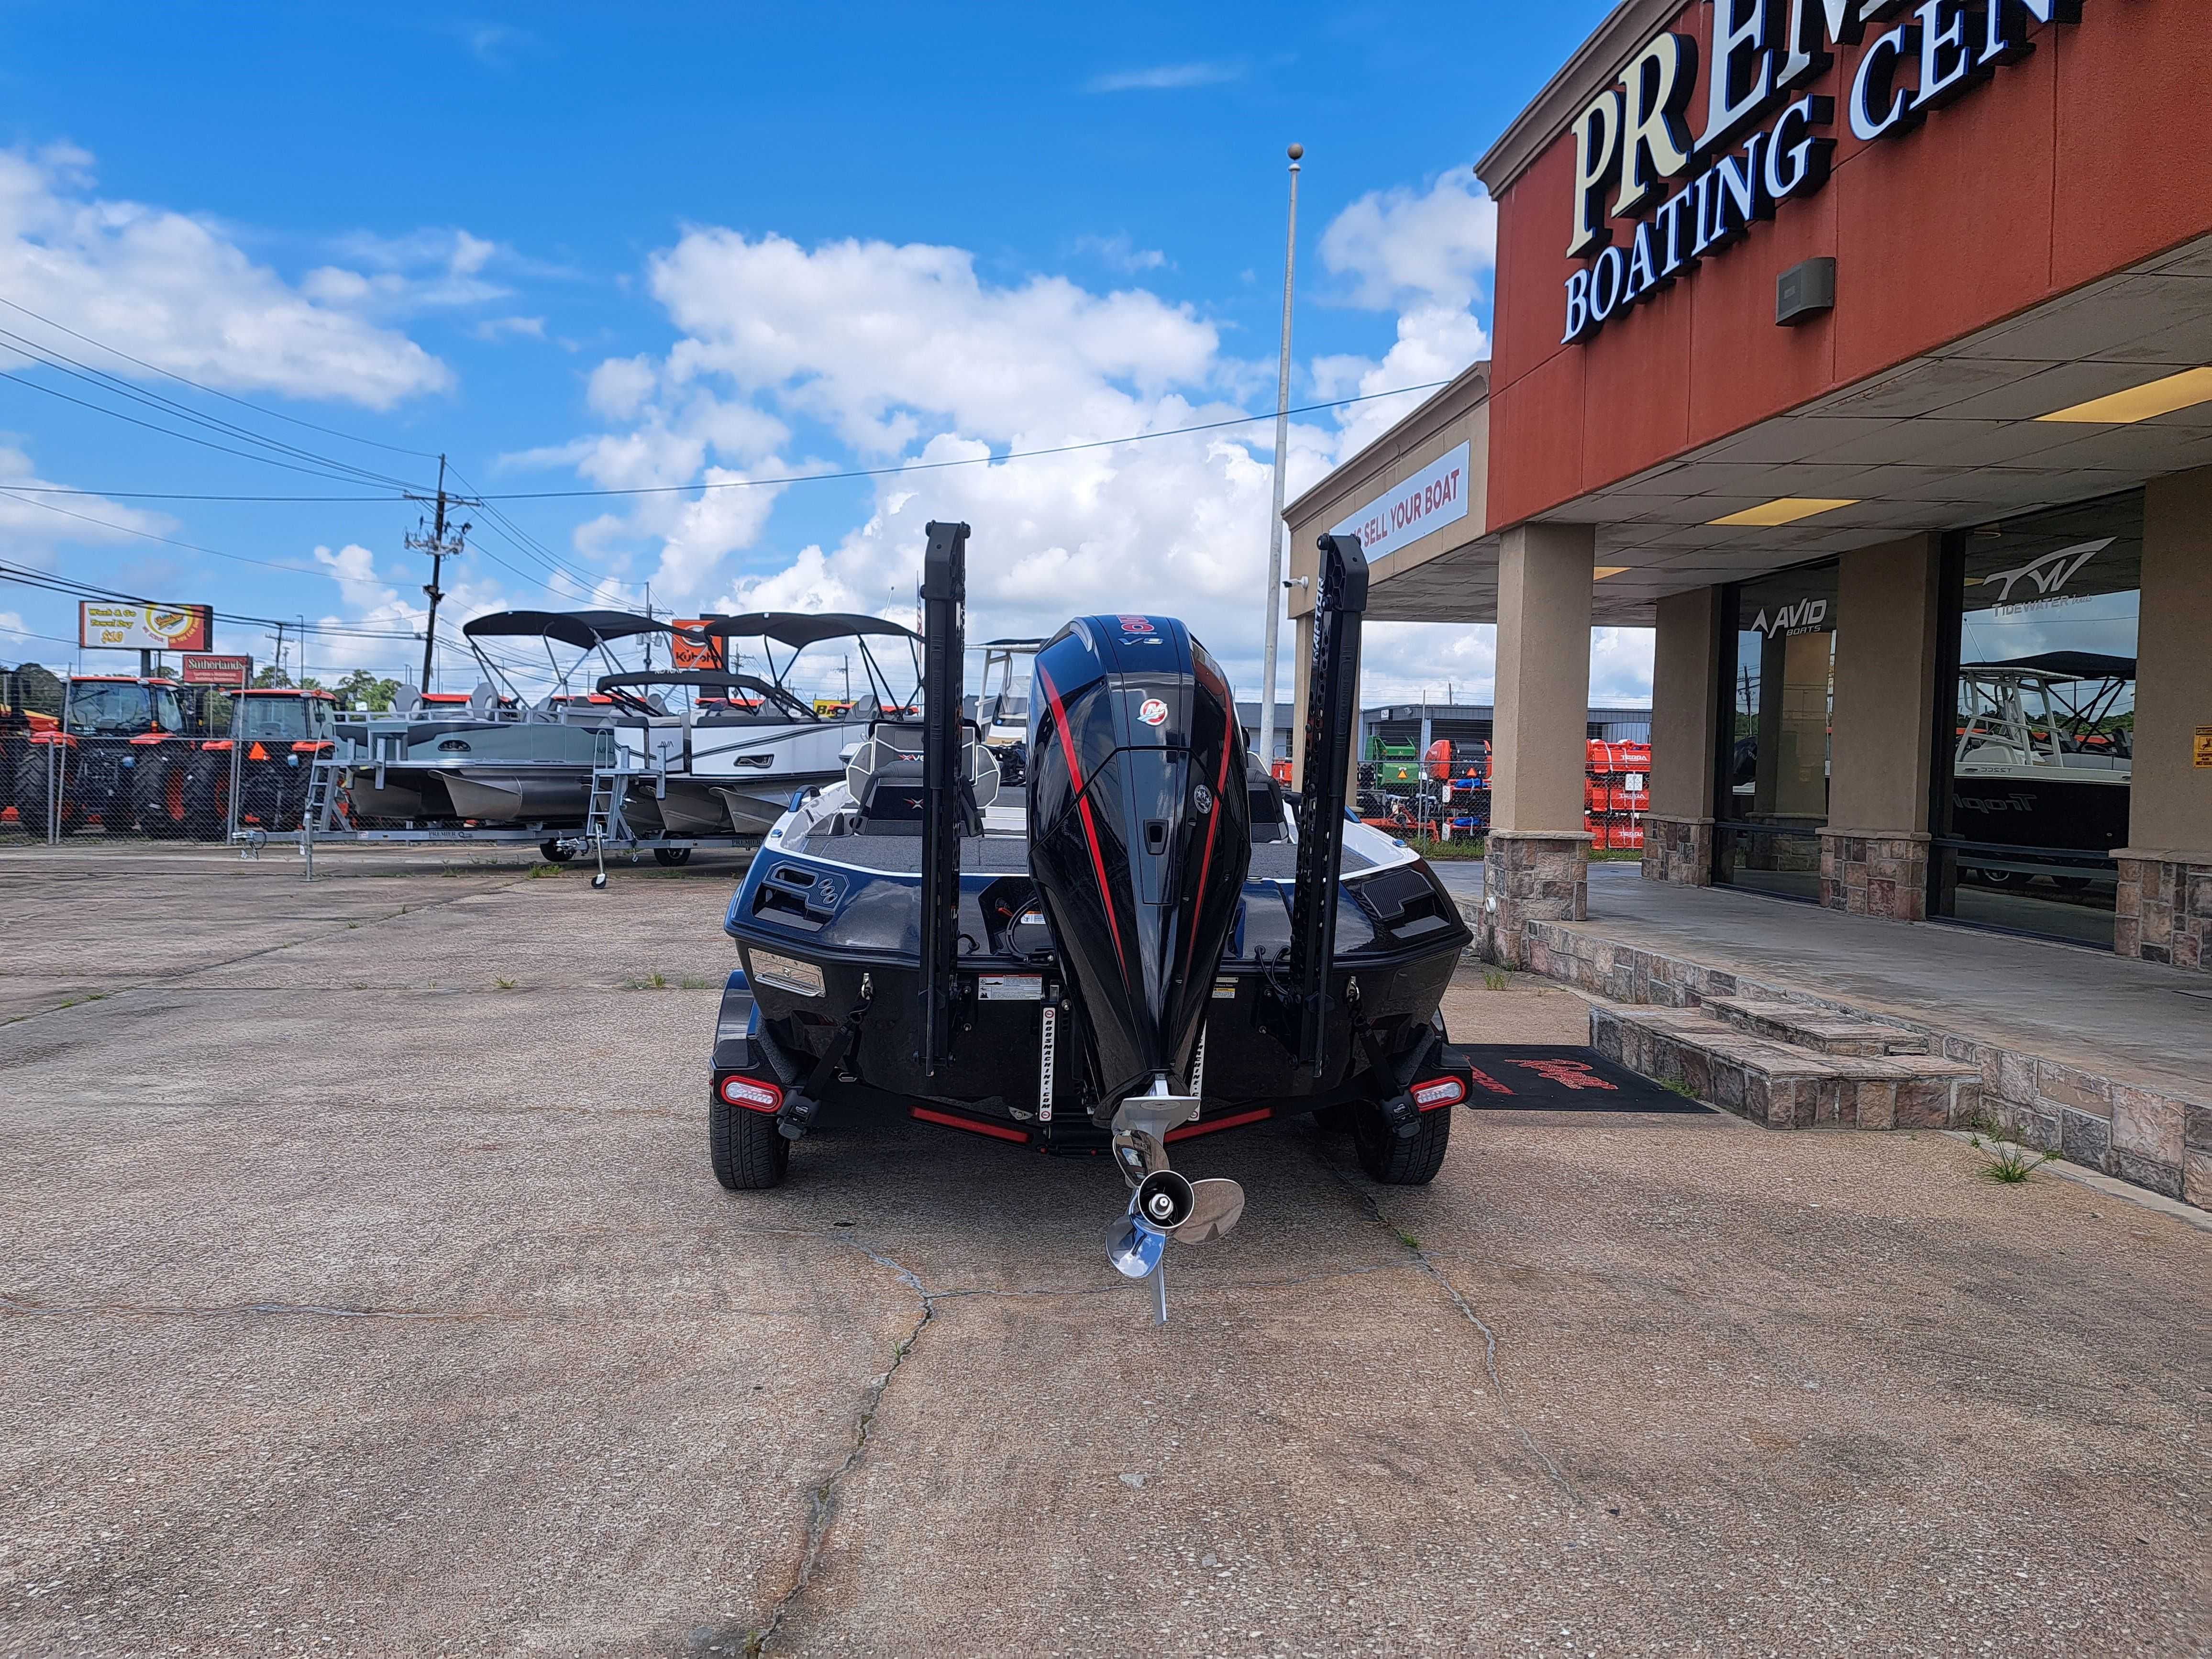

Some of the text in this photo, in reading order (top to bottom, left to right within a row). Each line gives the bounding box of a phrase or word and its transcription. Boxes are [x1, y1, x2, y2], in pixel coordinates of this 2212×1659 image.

[1561, 93, 1815, 344] BOATING
[1364, 468, 1460, 548] SELL YOUR BOAT
[1768, 598, 1827, 639] AVID
[1786, 624, 1822, 636] BOATS
[188, 657, 243, 670] Sutherlands
[676, 652, 719, 663] Kubot
